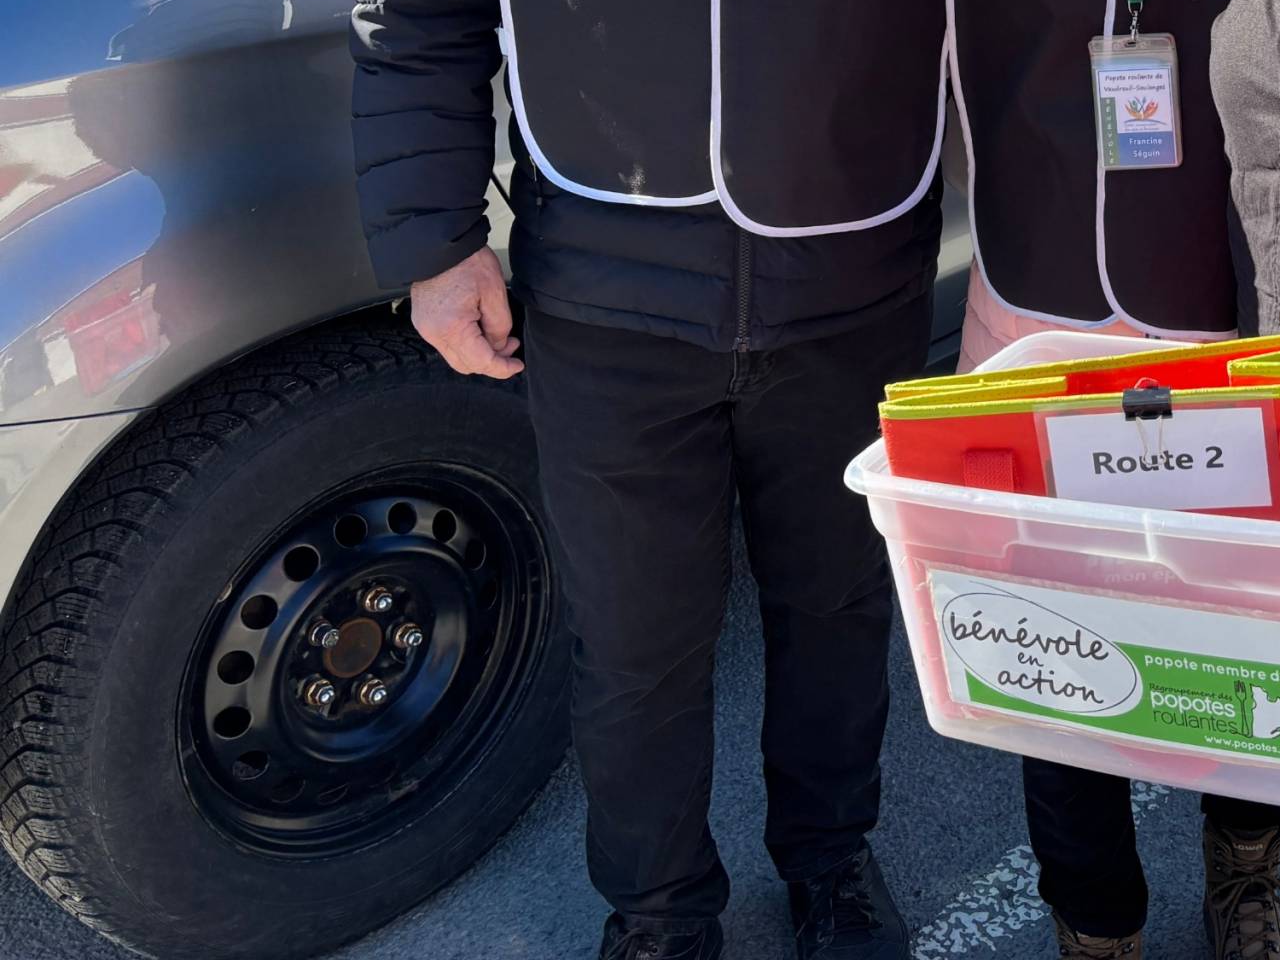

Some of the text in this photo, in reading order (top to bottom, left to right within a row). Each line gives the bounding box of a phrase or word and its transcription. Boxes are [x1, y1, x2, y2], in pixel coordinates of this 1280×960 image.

[1092, 446, 1224, 475] Route 2
[949, 610, 1109, 661] bénévole
[1017, 651, 1044, 667] en
[1144, 654, 1198, 671] popote
[1202, 660, 1266, 680] membre
[997, 669, 1104, 704] action
[1150, 683, 1233, 701] Regroupement des
[1150, 691, 1236, 718] popotes
[1153, 709, 1240, 735] roulantes
